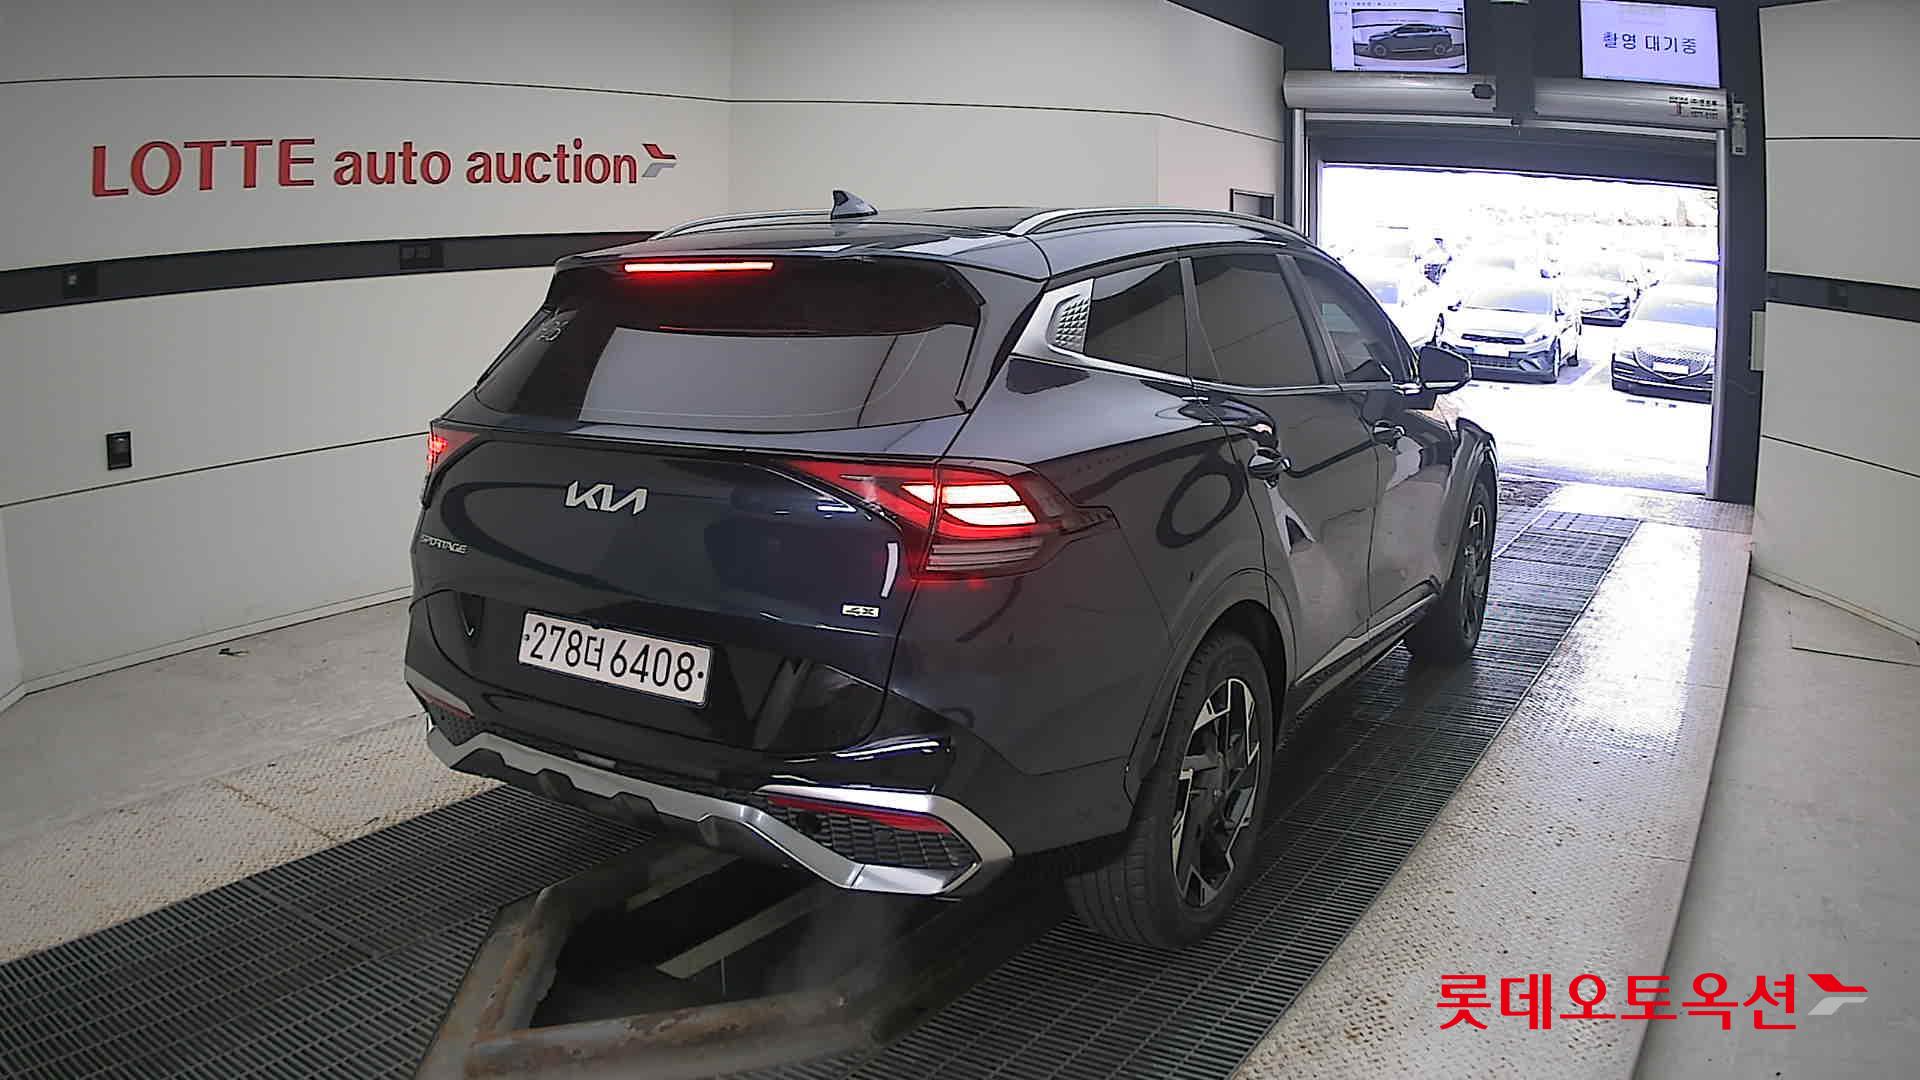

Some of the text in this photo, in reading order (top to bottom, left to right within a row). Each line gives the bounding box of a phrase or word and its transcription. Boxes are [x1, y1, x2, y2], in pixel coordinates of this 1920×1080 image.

[1645, 35, 1696, 55] 대기중
[91, 137, 639, 197] LOTTE auto auction
[565, 480, 648, 515] KIA
